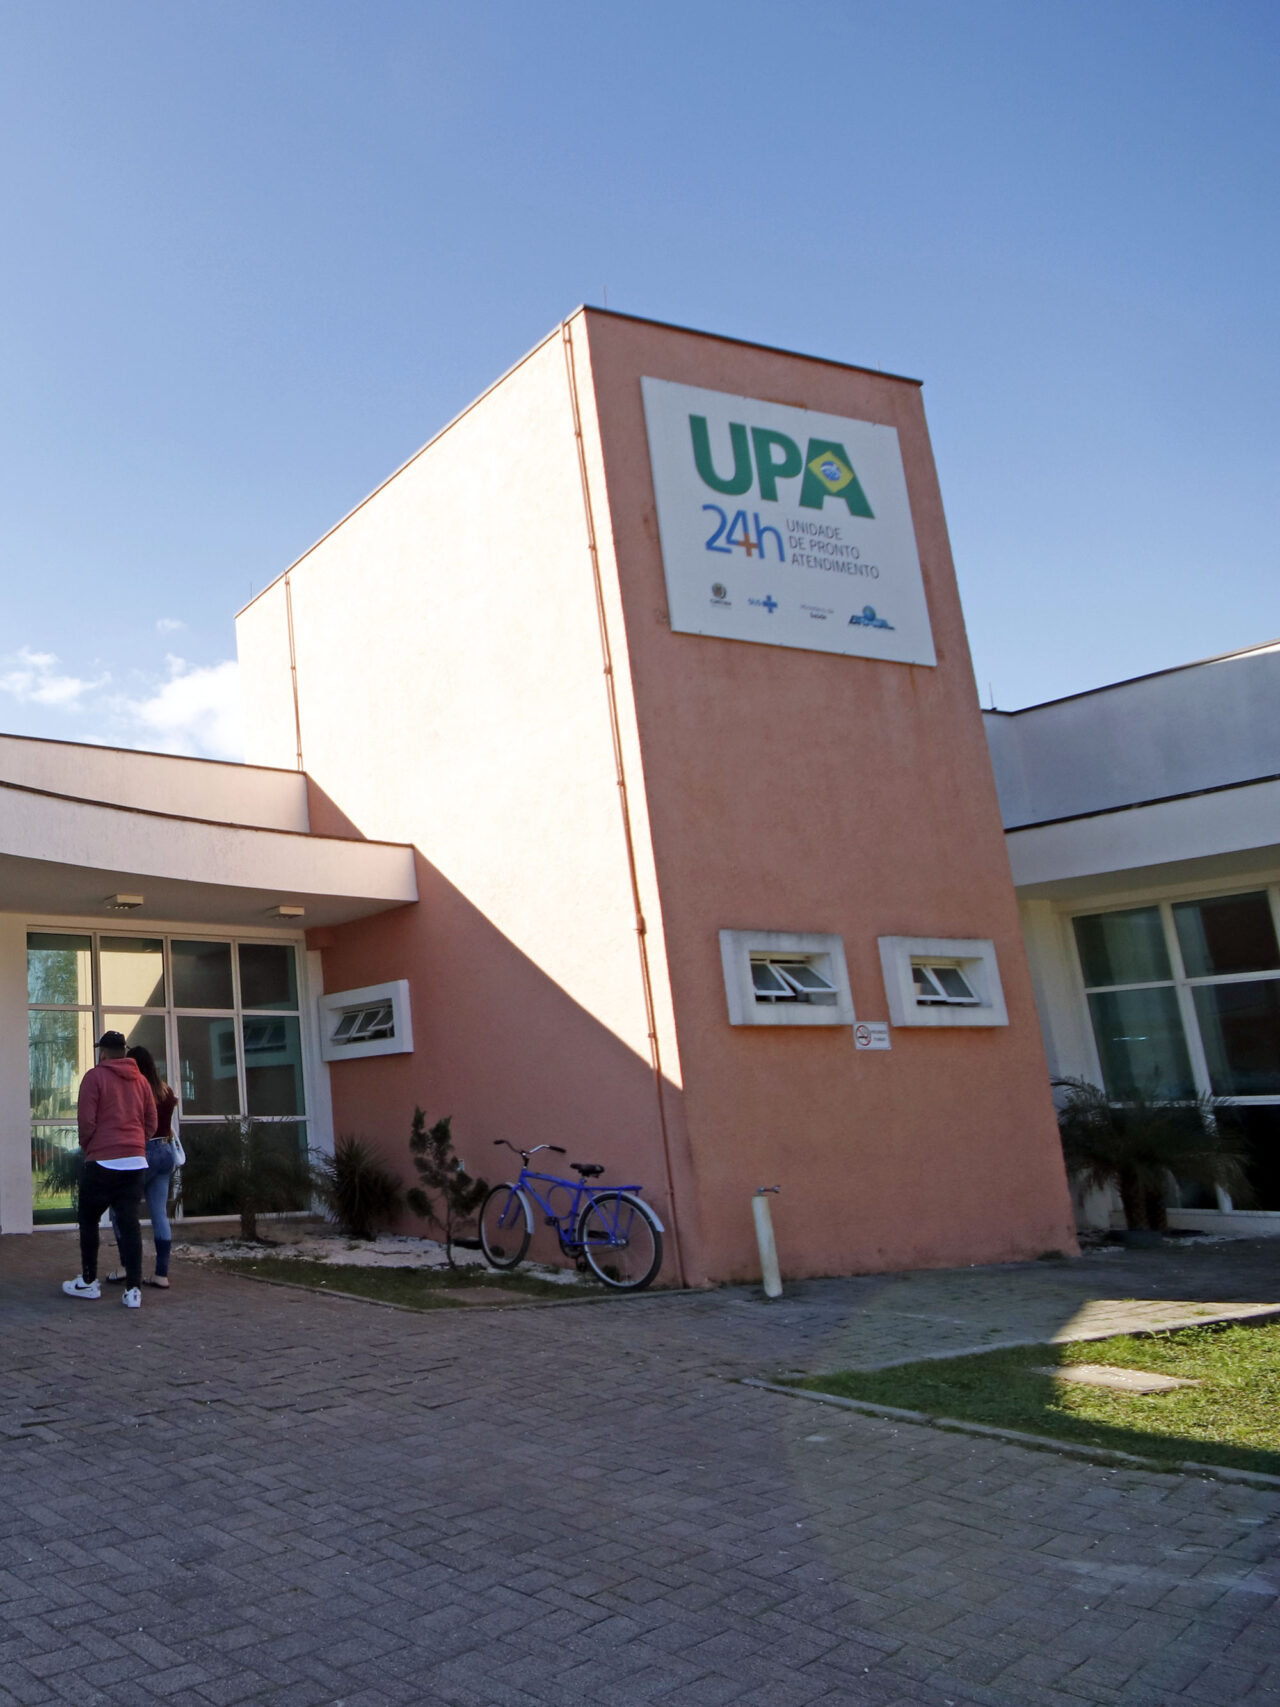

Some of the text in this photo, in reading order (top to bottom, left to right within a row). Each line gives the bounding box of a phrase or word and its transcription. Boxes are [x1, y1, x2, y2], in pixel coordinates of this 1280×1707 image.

[688, 413, 876, 520] UPA
[701, 503, 786, 562] 24h
[786, 518, 843, 541] UNIDADE
[789, 535, 860, 560] DE PRONTO
[791, 553, 880, 579] ATENDIMENTO
